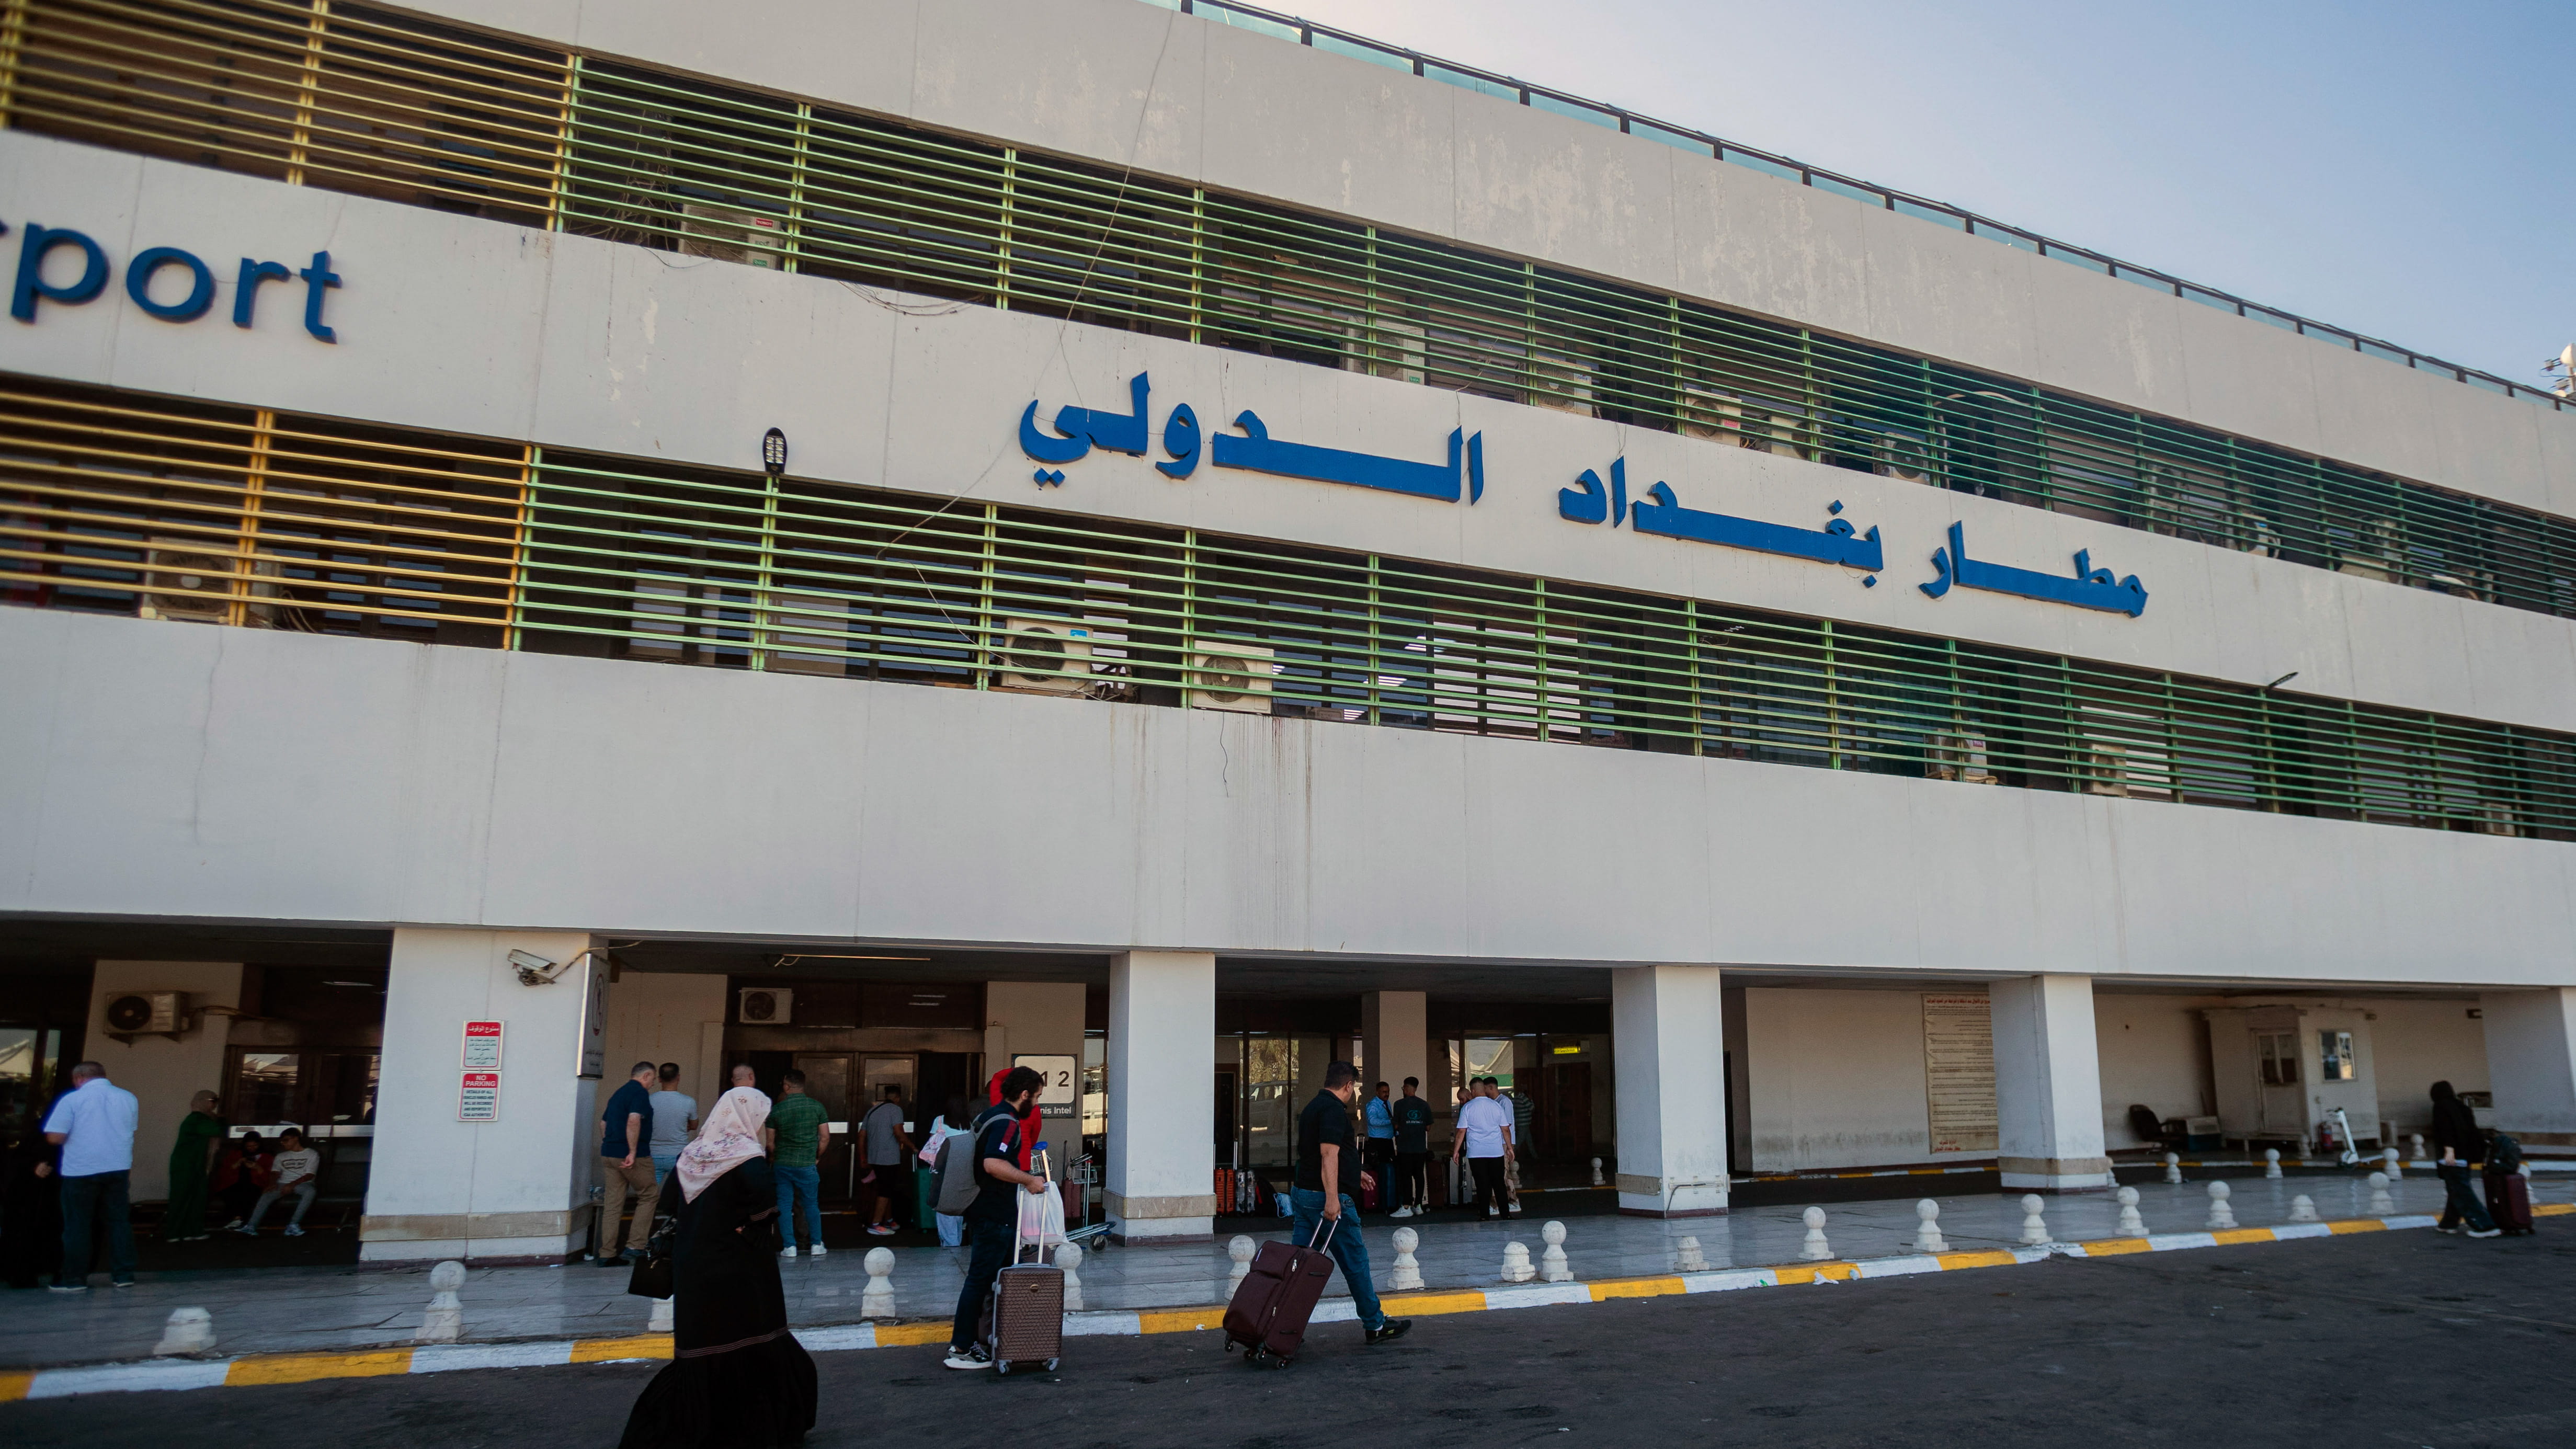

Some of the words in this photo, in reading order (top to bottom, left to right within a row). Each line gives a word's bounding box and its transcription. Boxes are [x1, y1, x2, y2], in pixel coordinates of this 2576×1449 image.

[0, 219, 343, 344] port
[1019, 370, 1484, 506] الدولي
[1558, 455, 1884, 589] بغداد
[1918, 520, 2149, 618] مطار
[1058, 1070, 1069, 1087] 2
